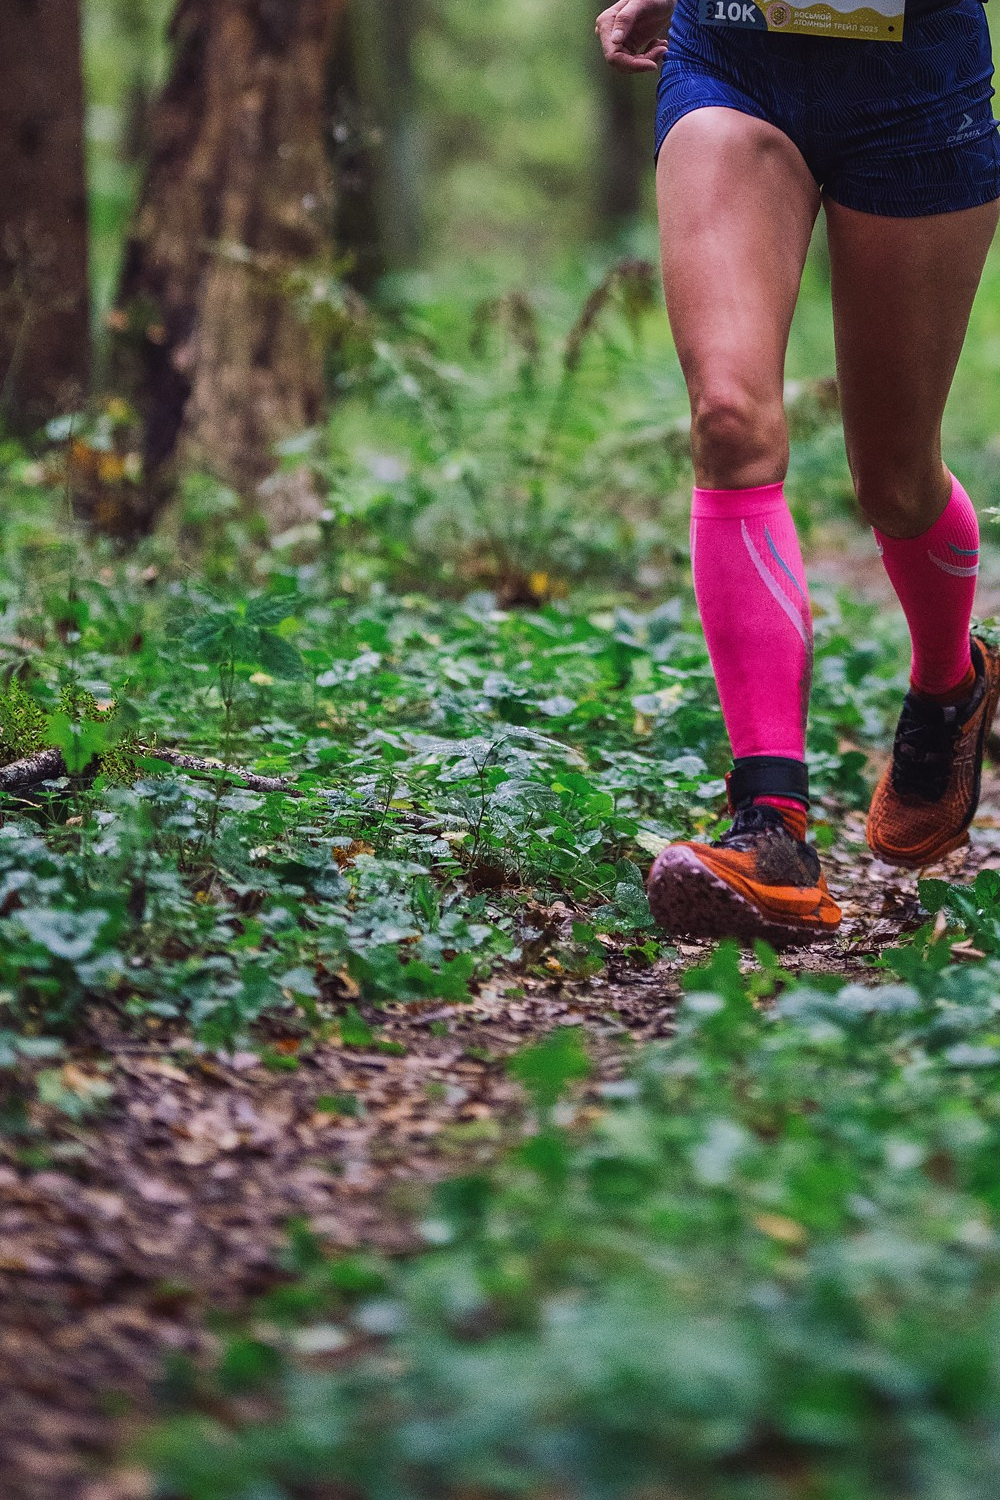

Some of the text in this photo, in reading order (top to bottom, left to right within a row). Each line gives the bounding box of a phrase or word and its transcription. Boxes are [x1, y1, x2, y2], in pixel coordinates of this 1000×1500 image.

[714, 1, 756, 23] 10K
[794, 10, 832, 21] ВОСЬМОЙ
[793, 19, 879, 33] АТОМНЫЙ ТРЕЙЛ 2025
[946, 129, 981, 142] DEMIX
